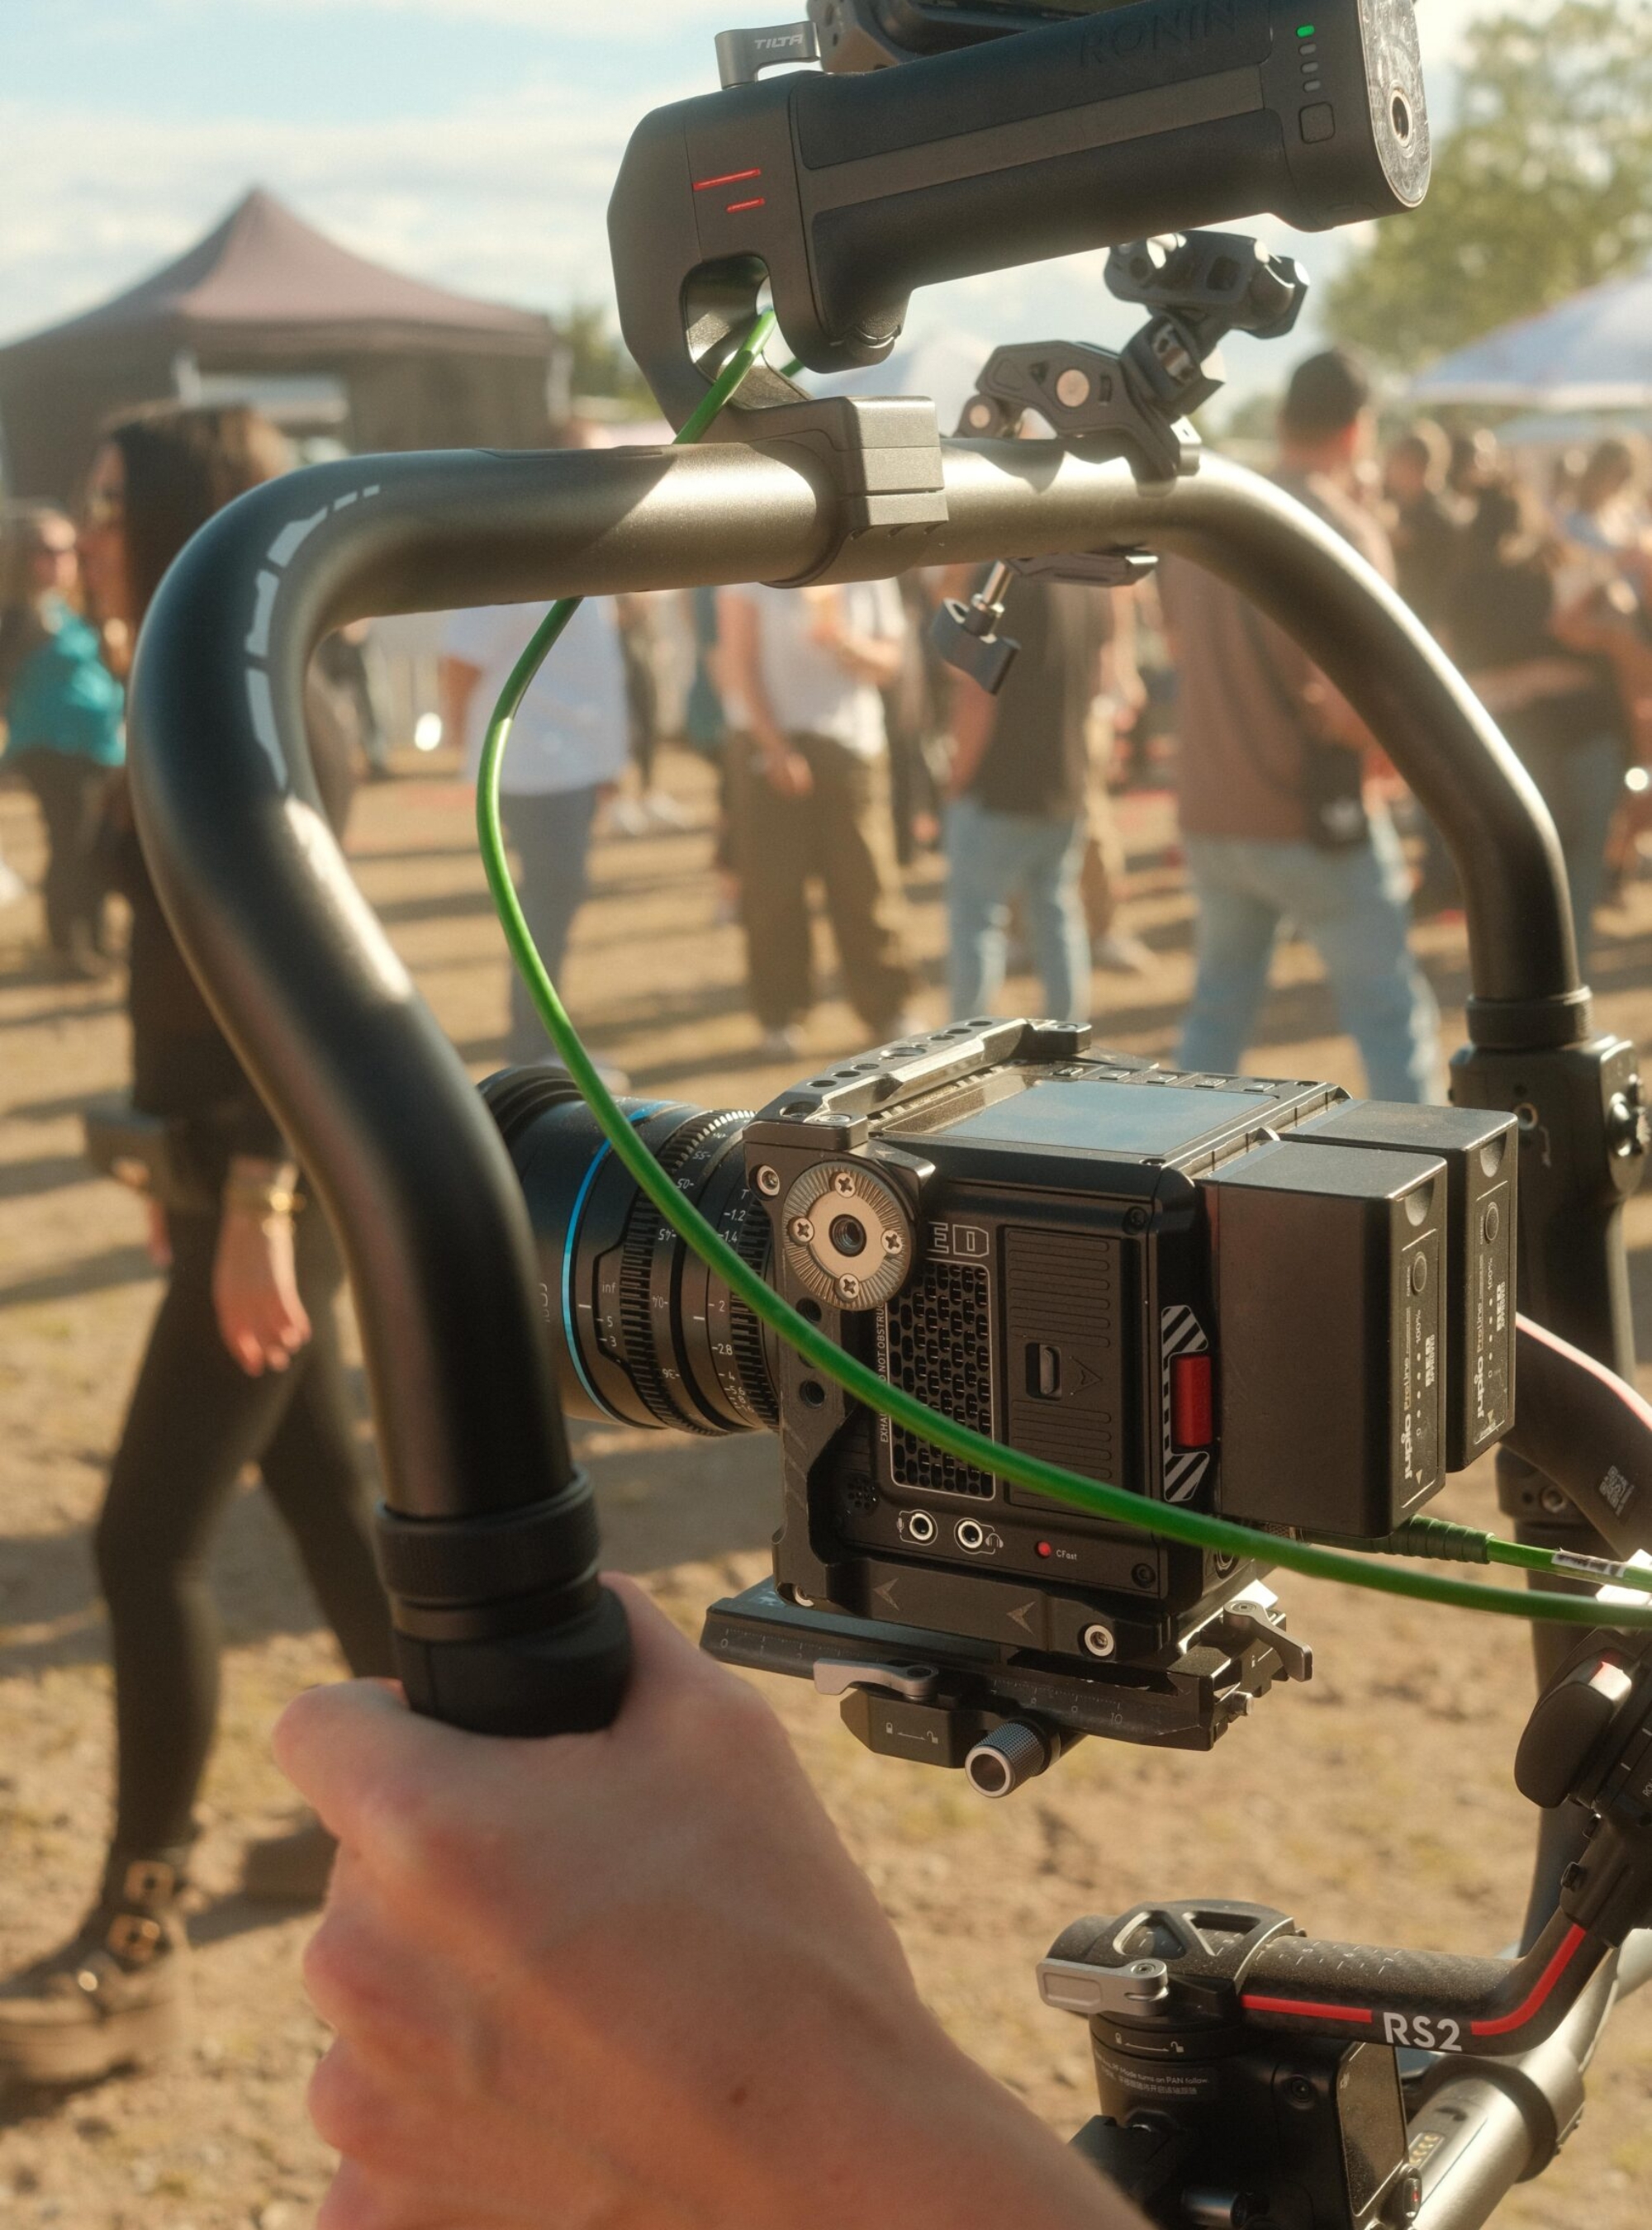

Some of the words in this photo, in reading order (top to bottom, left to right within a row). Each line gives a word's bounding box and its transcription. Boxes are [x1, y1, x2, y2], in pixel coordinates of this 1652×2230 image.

[753, 34, 804, 50] TILTA
[742, 1189, 749, 1200] T
[731, 1208, 746, 1222] 1.2
[926, 1222, 990, 1258] ED
[602, 1282, 616, 1293] inf
[719, 1300, 725, 1312] 2
[606, 1316, 614, 1327] 5
[610, 1336, 617, 1347] 3
[877, 1352, 886, 1374] NOT
[1474, 1356, 1485, 1419] jupio
[1401, 1413, 1413, 1479] jupio
[1056, 1549, 1077, 1560] CFast
[1110, 1712, 1123, 1725] 10
[1383, 2012, 1462, 2052] RS2
